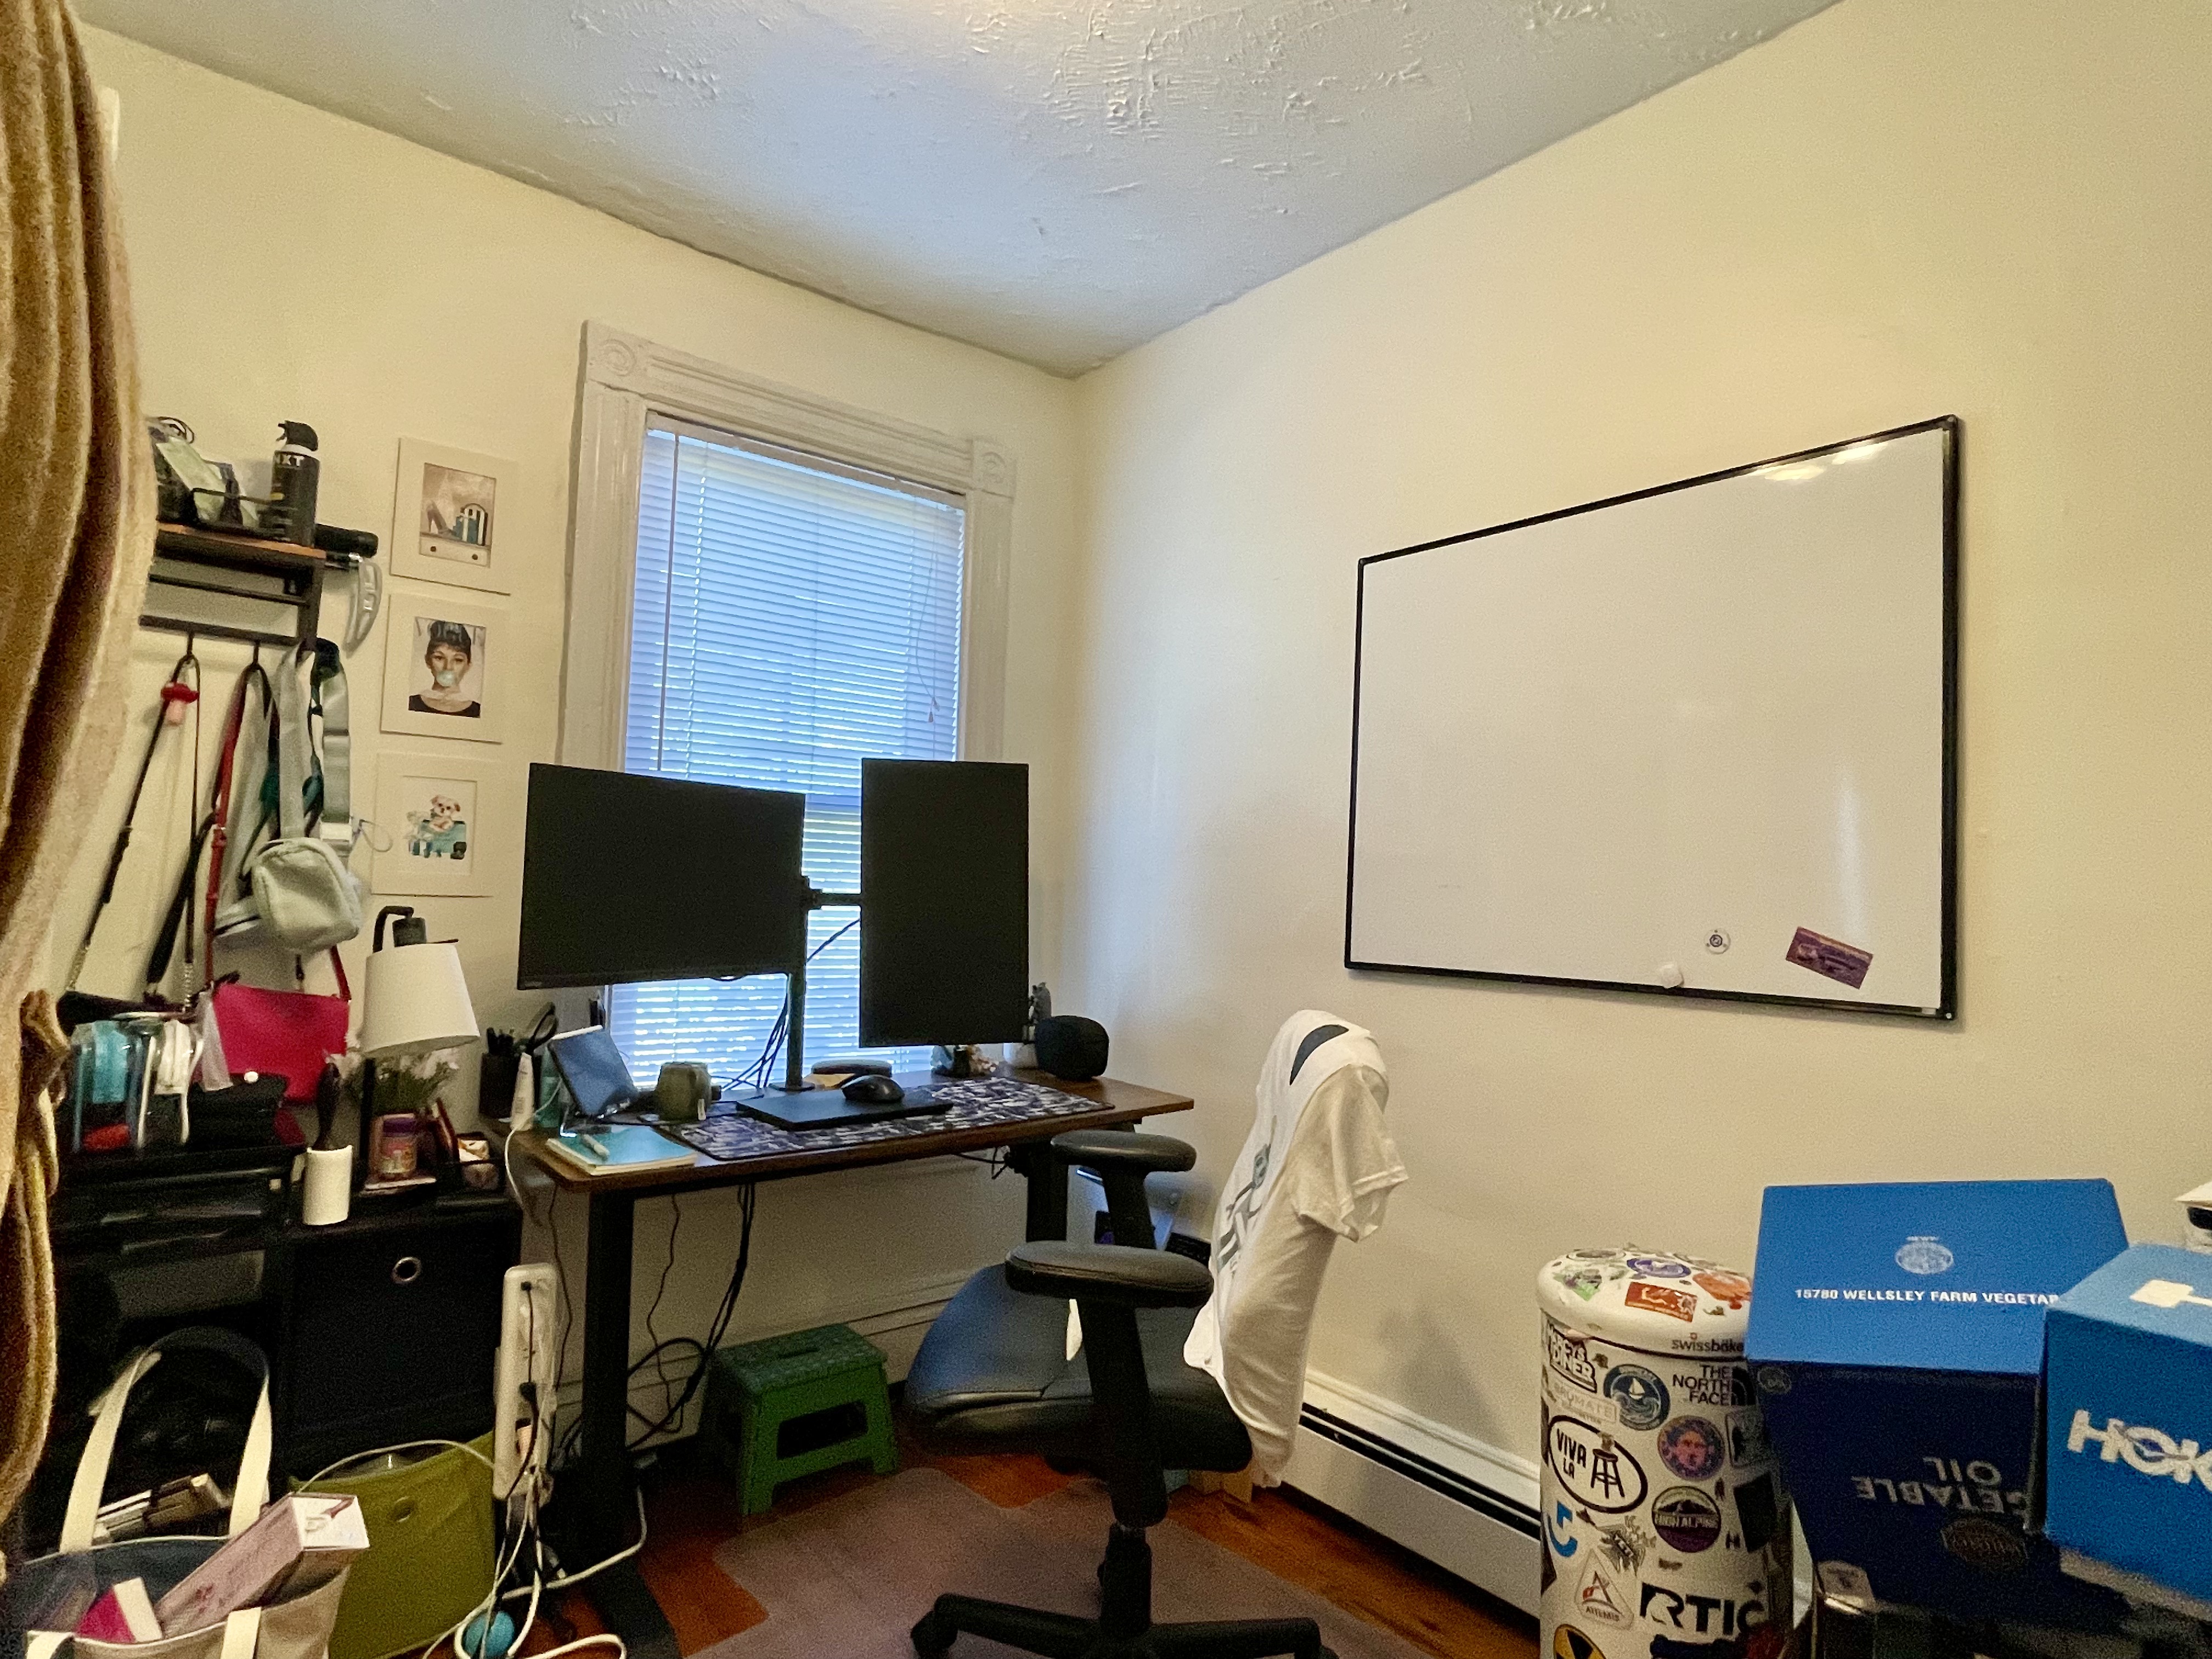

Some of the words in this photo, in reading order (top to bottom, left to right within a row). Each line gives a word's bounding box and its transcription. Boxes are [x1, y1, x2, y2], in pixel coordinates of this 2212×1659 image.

[1843, 1289, 1924, 1301] WELLSLEY
[1930, 1291, 1977, 1303] FARM
[1700, 1365, 1730, 1379] THE
[1673, 1374, 1731, 1392] NORTH
[1690, 1390, 1731, 1406] FACE
[1557, 1428, 1586, 1468] VIVA
[1564, 1457, 1575, 1479] LA
[1923, 1457, 2002, 1485] OIL
[1640, 1582, 1765, 1635] RTIC
